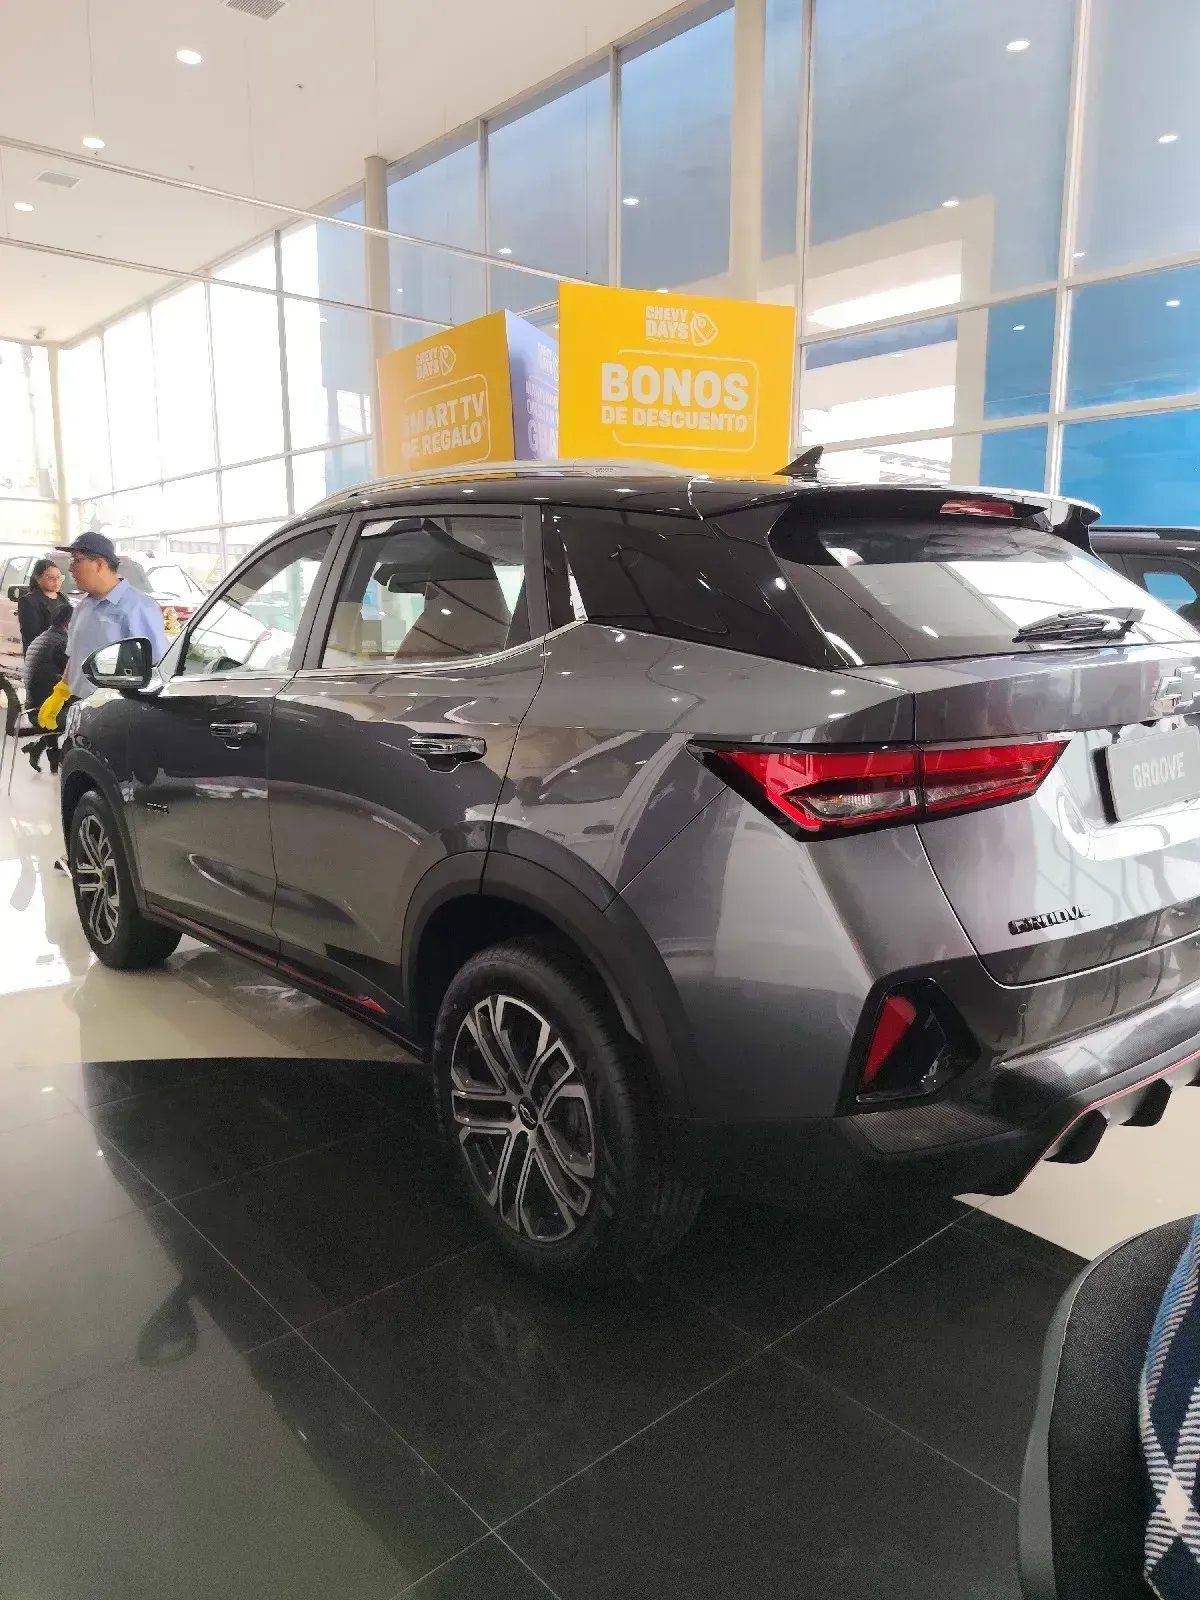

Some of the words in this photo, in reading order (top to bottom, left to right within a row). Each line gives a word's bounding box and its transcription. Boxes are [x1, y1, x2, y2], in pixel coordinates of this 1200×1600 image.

[645, 306, 689, 323] CHEVY
[645, 319, 689, 340] DAYS
[416, 359, 440, 380] DAYS
[601, 362, 749, 411] BONOS
[459, 390, 485, 421] TV
[601, 405, 628, 425] DE
[632, 408, 749, 433] DESCUENTO
[421, 421, 483, 456] REGALO
[1132, 751, 1186, 791] GROOVE
[1008, 904, 1091, 935] GROOVE
